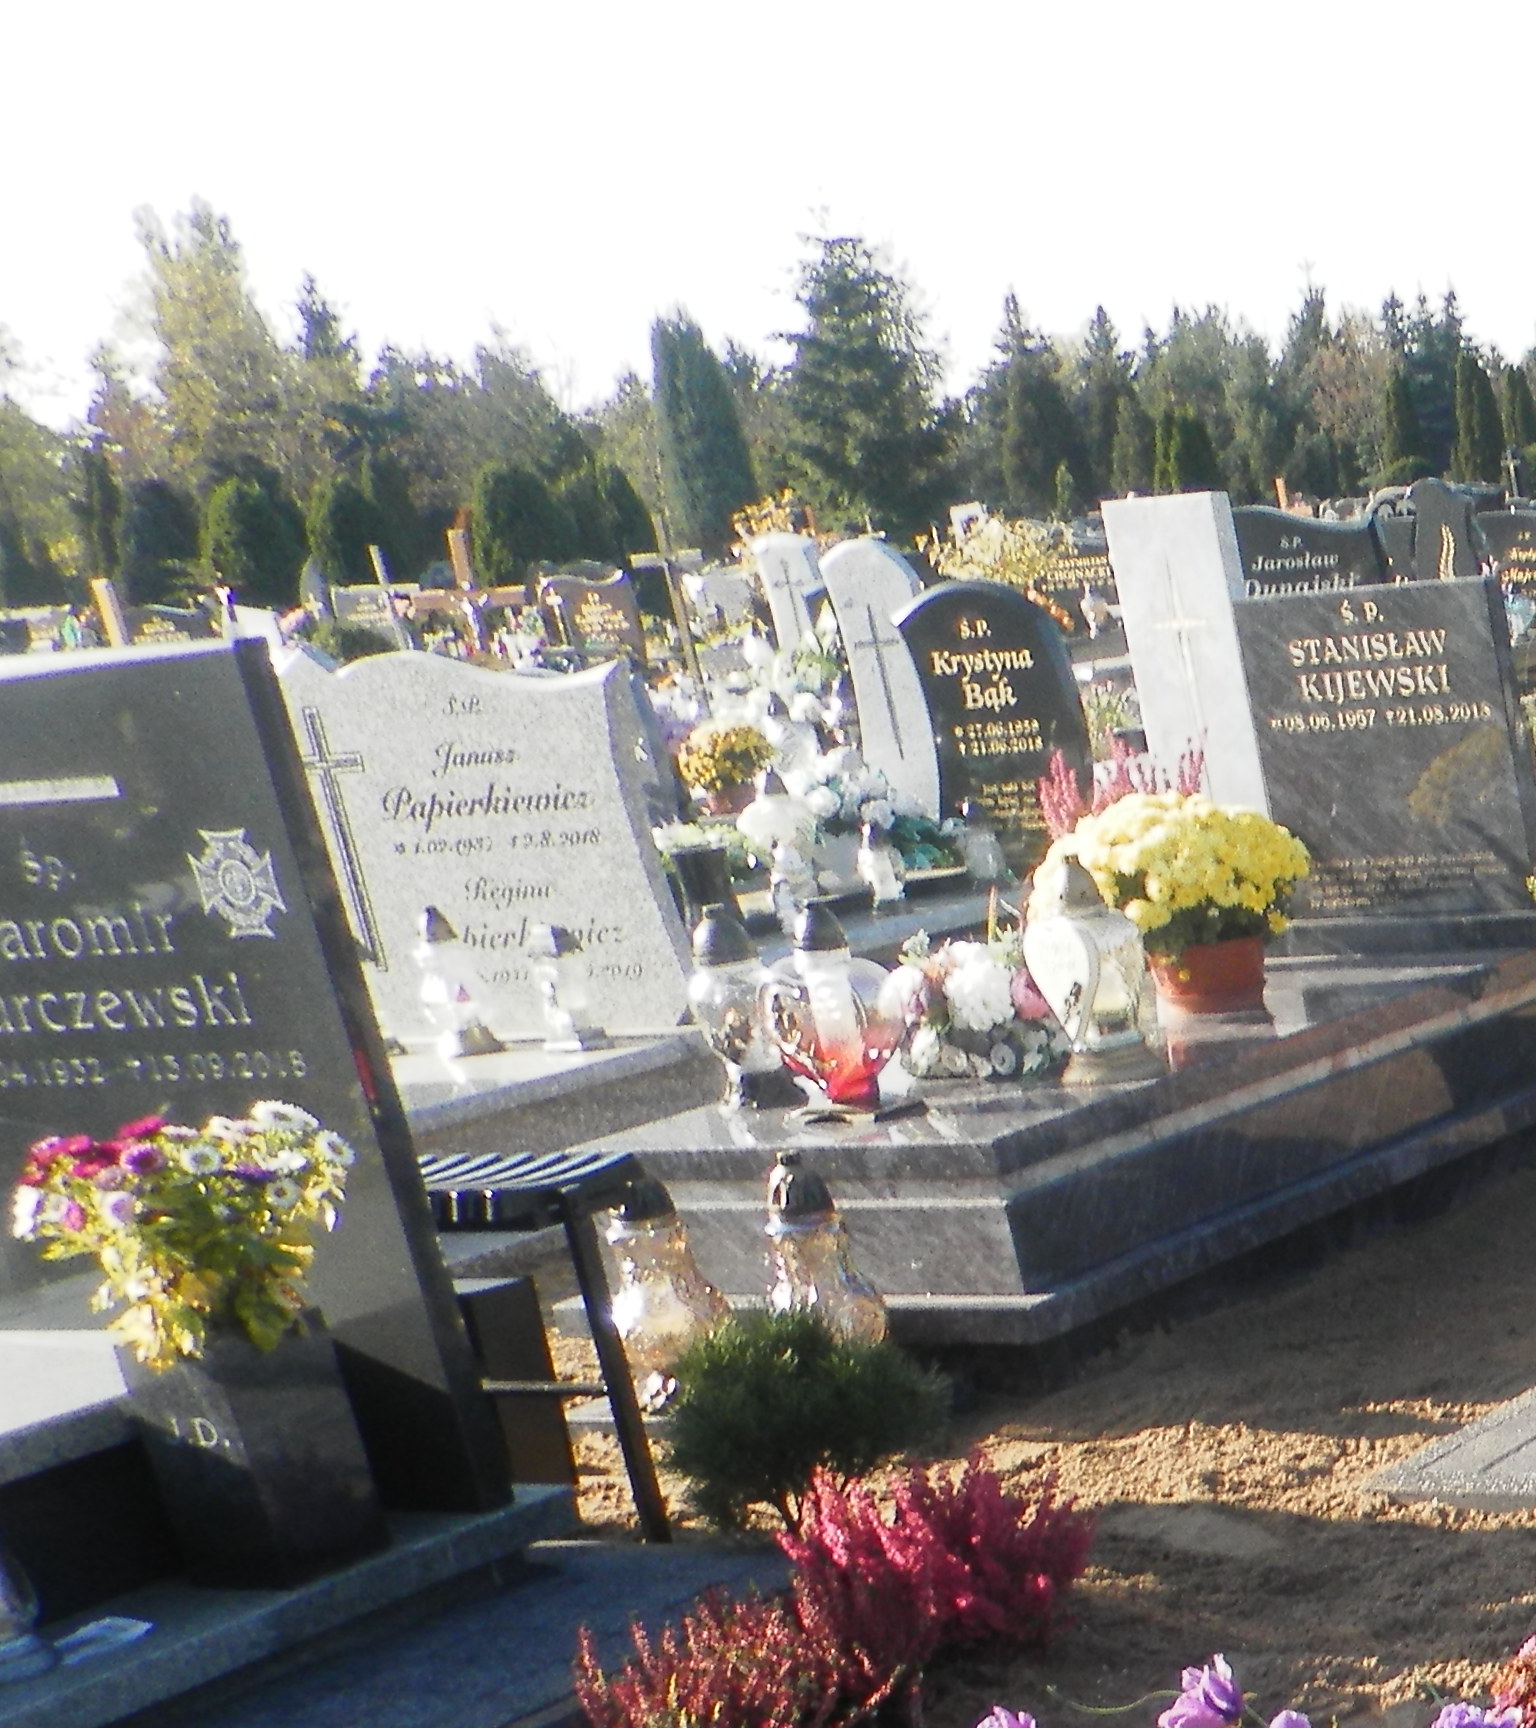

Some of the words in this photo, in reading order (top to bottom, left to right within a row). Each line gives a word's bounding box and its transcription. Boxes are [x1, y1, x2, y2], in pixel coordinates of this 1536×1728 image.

[930, 648, 1034, 682] Krystyna
[1288, 628, 1446, 667] STANISŁAW
[963, 677, 1018, 713] Bąk
[1297, 663, 1451, 706] KIJEWSKI
